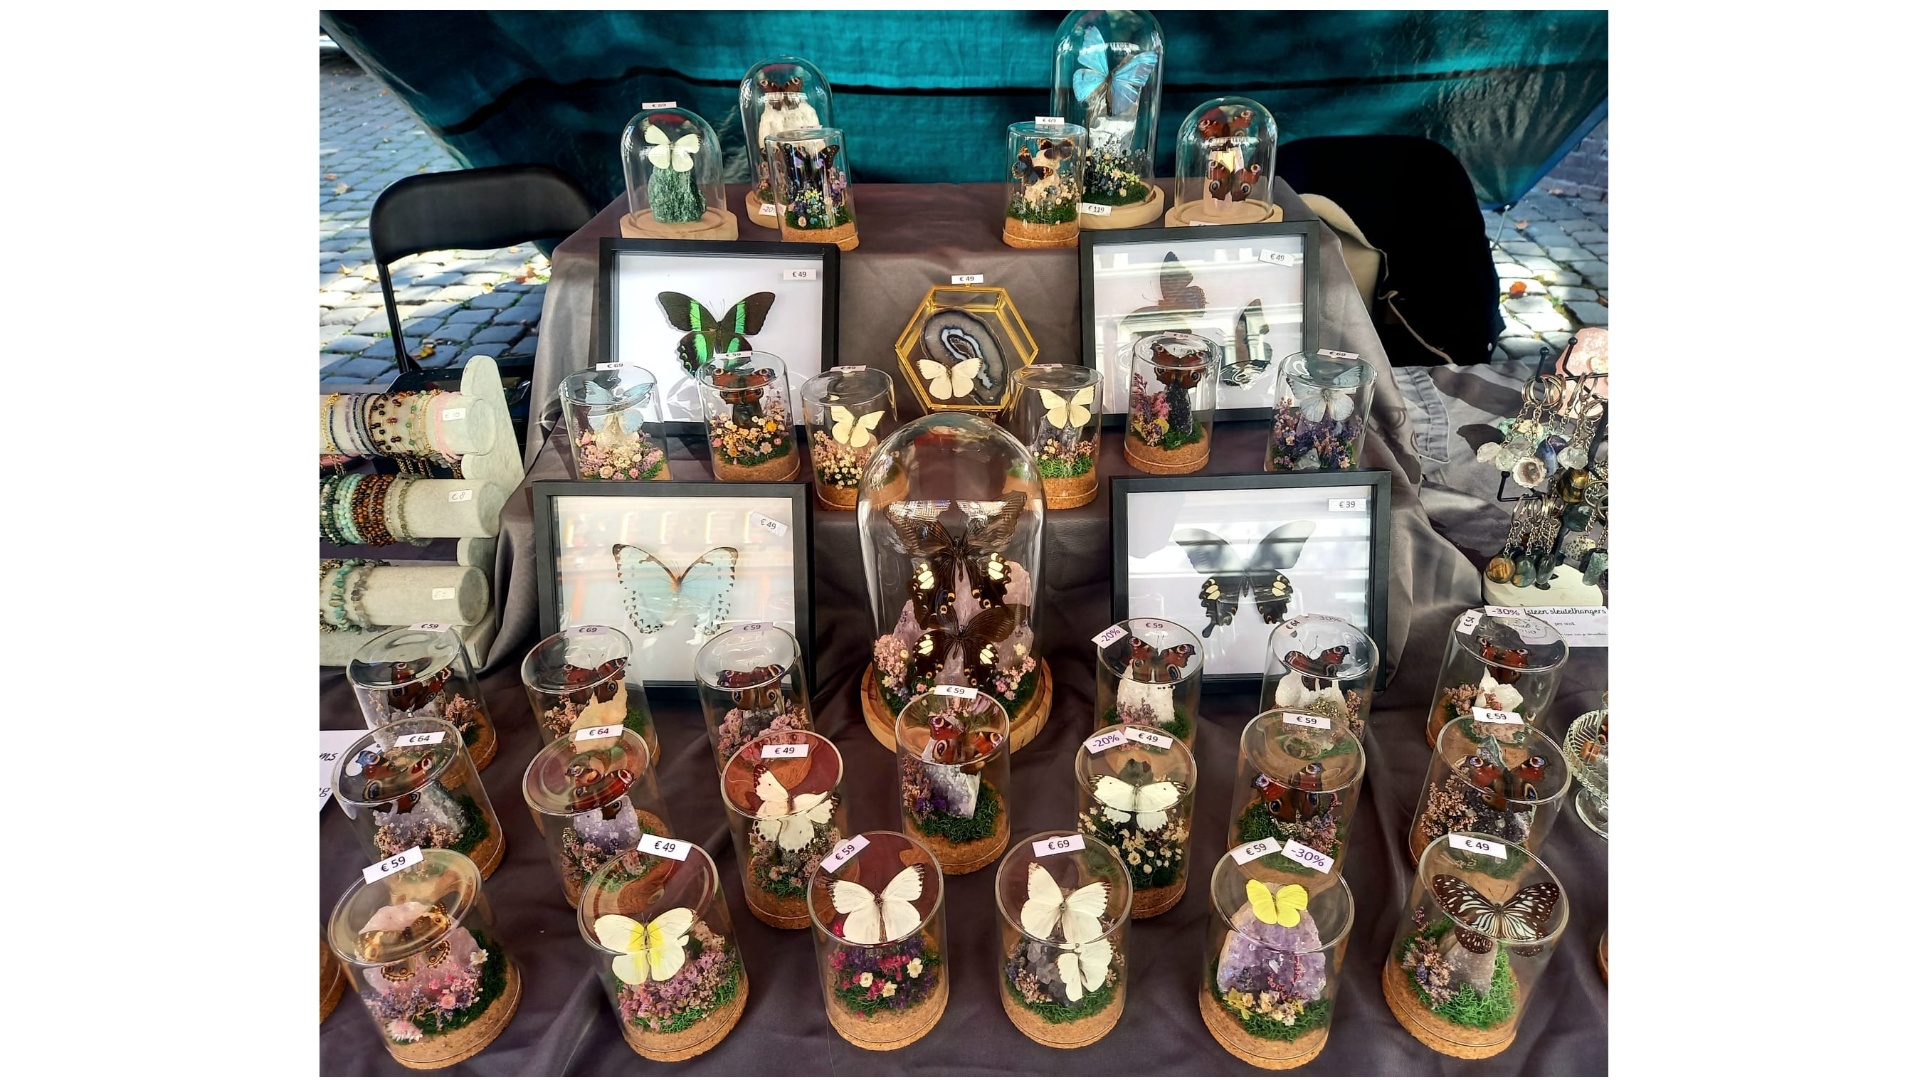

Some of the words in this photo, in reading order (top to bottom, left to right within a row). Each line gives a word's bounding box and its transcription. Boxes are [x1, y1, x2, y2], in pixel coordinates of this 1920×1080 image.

[767, 522, 776, 530] 49
[1292, 619, 1300, 627] 64
[1100, 628, 1120, 643] -20%
[1092, 734, 1119, 748] -20%
[1146, 734, 1158, 742] 49
[663, 842, 675, 852] 49
[1058, 840, 1070, 848] 69
[1253, 843, 1267, 852] 59
[1475, 842, 1490, 850] 49
[842, 844, 855, 855] 59
[391, 856, 406, 868] 59
[1291, 849, 1325, 867] -30%
